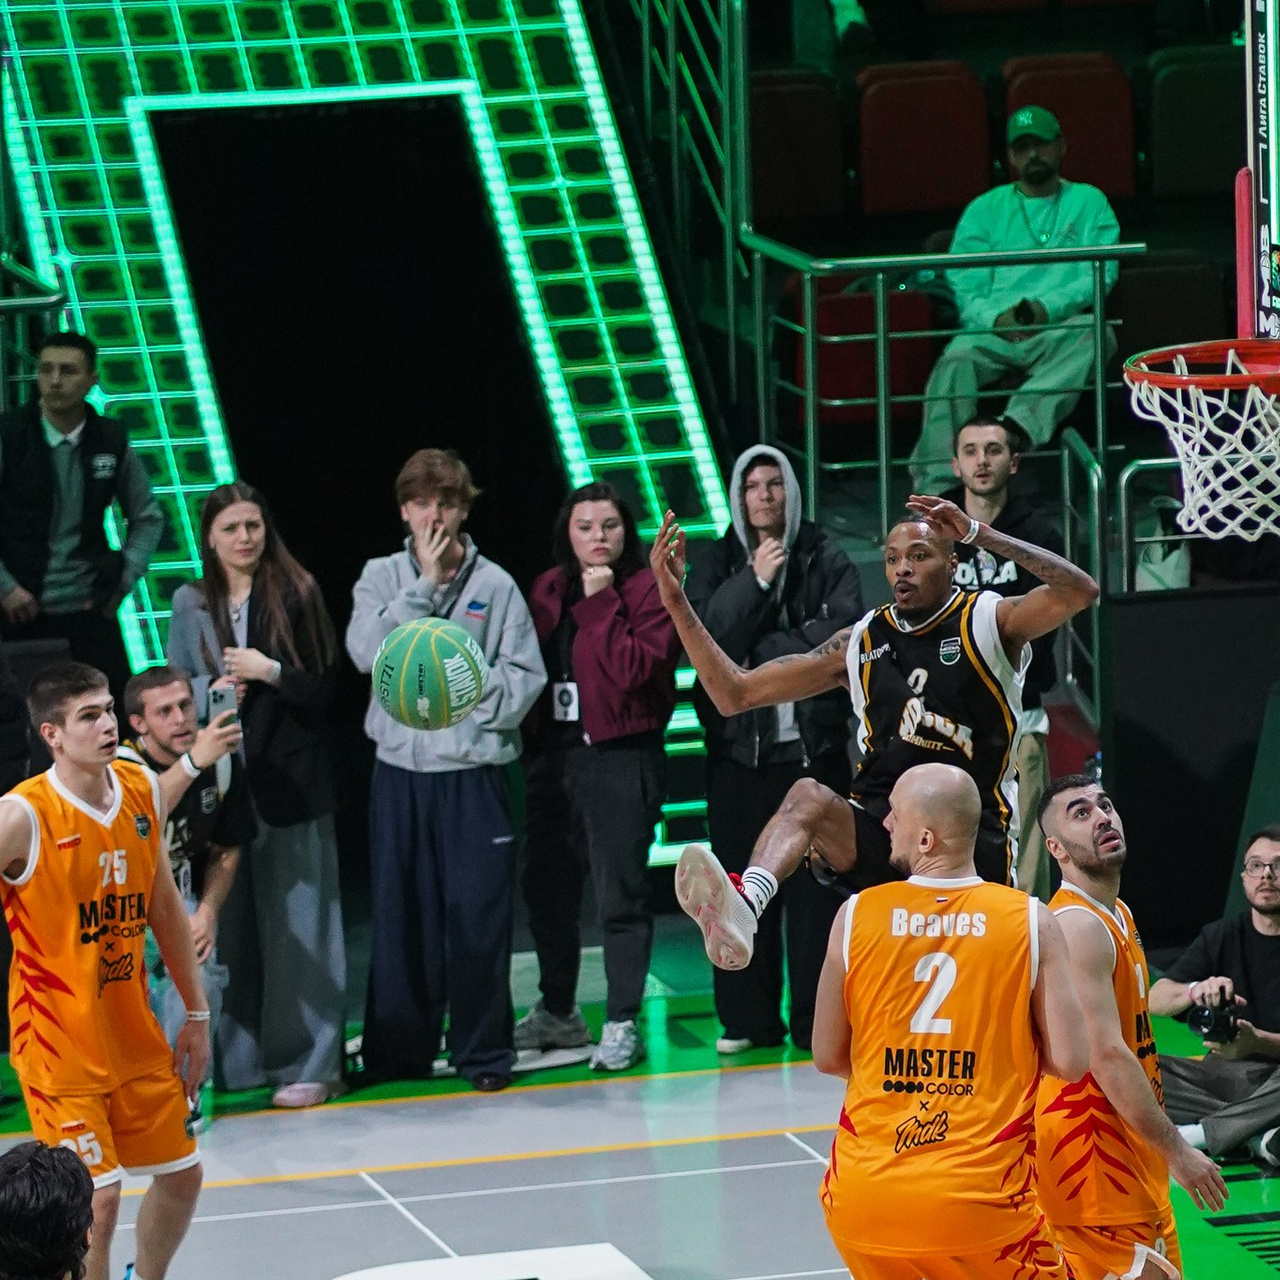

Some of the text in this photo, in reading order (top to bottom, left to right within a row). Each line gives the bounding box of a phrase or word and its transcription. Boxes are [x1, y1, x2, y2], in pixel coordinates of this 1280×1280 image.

[98, 849, 127, 888] 25
[892, 908, 987, 937] Beaves
[909, 952, 957, 1035] 2
[884, 1047, 976, 1079] MASTER
[926, 1082, 974, 1096] COLOR
